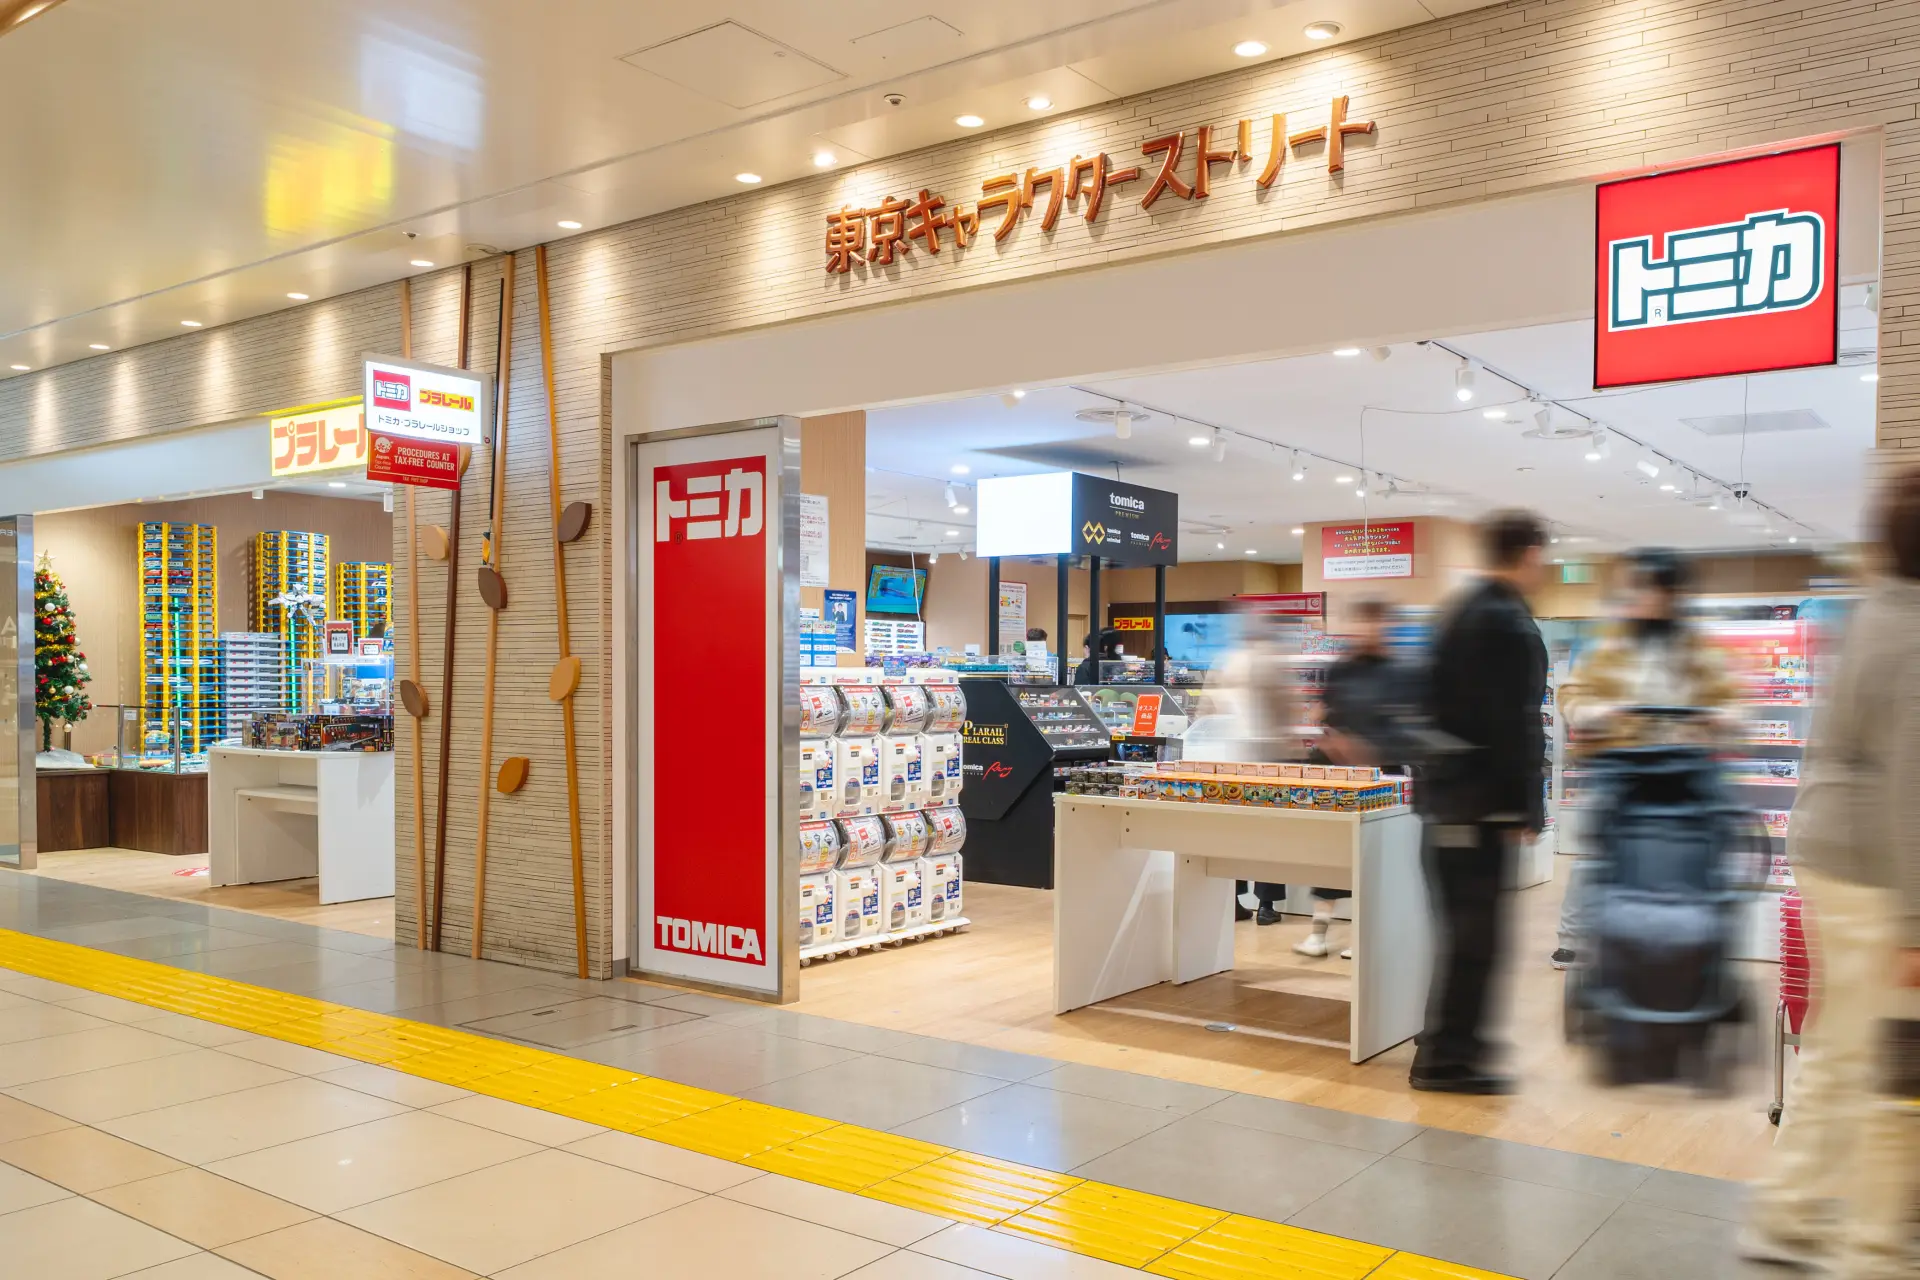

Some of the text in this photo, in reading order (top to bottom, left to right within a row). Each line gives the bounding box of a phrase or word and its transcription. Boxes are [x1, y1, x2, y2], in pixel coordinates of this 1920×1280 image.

[825, 95, 1377, 274] 東京キャラクターストリート
[1608, 207, 1825, 332] トミカ
[375, 380, 410, 402] トミカ
[420, 389, 472, 411] プラレール
[394, 455, 455, 471] TAX-FREE COUNTER
[397, 447, 451, 462] PROCEDURES AT
[656, 468, 763, 542] トミカ
[1109, 492, 1145, 510] tomica
[1130, 531, 1150, 541] tomica
[1114, 619, 1151, 629] プラレール
[963, 720, 1005, 737] PLARAIL
[963, 736, 1005, 745] REAL CLASS
[656, 915, 763, 961] TOMICA
